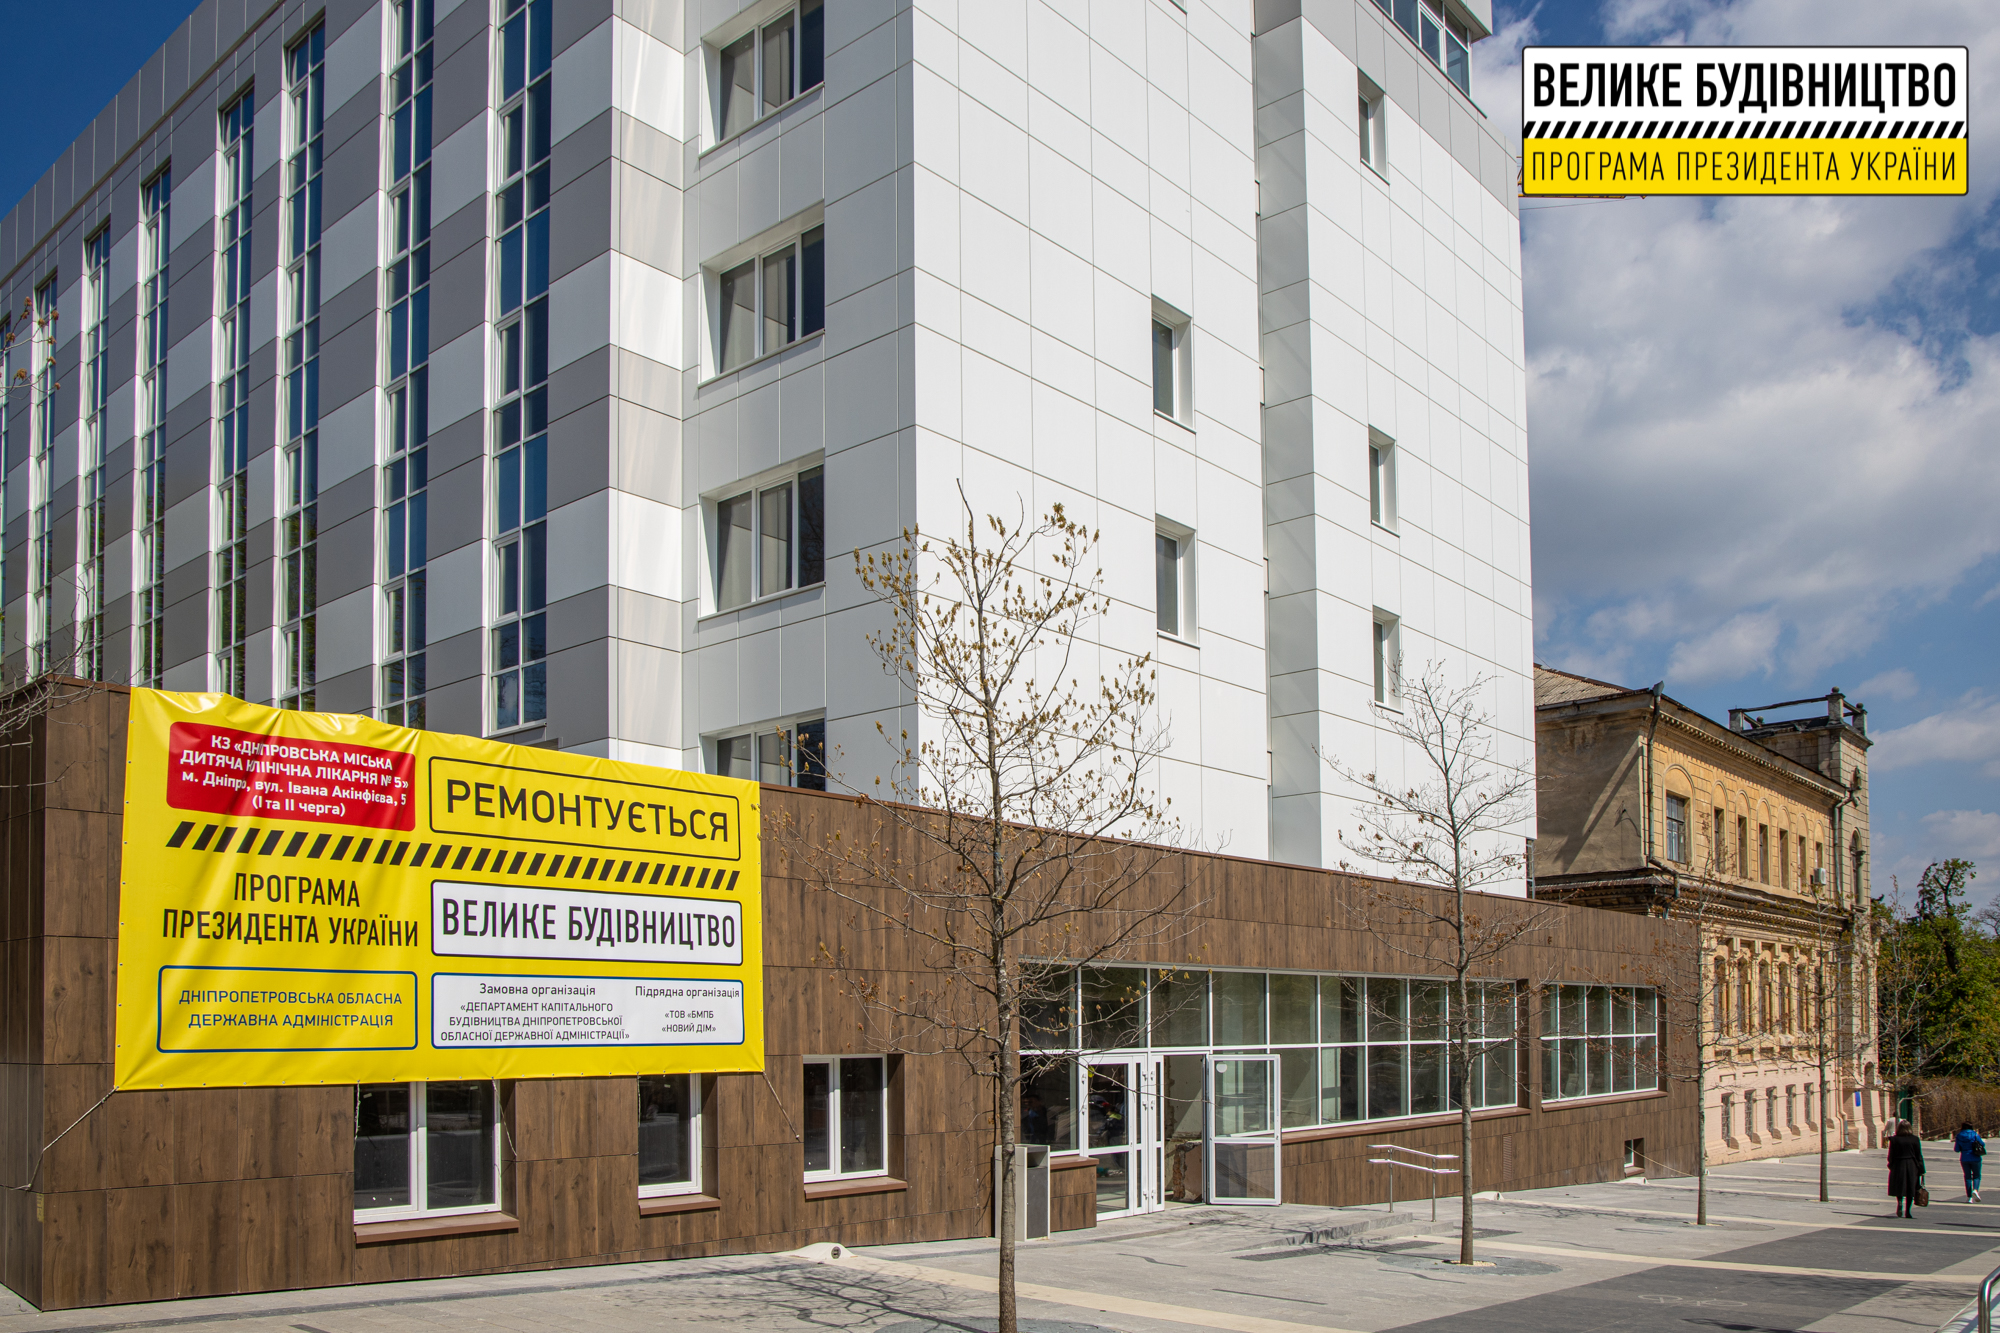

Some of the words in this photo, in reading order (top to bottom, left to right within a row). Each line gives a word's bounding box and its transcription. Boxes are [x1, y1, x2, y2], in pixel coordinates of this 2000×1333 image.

[211, 734, 231, 750] КЗ
[344, 752, 393, 771] МІСЬКА
[180, 749, 243, 771] ДИТЯЧА
[315, 766, 378, 787] ЛІКАРНЯ
[380, 774, 392, 787] №
[394, 776, 409, 789] 5»
[181, 771, 199, 783] м.
[202, 771, 251, 792] Дніпро,
[255, 780, 284, 794] вул.
[288, 781, 329, 797] Івана
[331, 785, 398, 807] Акінфієва,
[401, 793, 407, 806] 5
[265, 798, 280, 811] та
[299, 802, 346, 817] черга)
[447, 779, 728, 843] РЕМОНТУЄТЬСЯ
[234, 872, 361, 908] ПРОГРАМА
[162, 908, 320, 945] ПРЕЗИДЕНТА
[328, 914, 419, 947] УКРАЇНИ
[442, 898, 557, 940] ВЕЛИКЕ
[568, 905, 735, 950] БУДІВНИЦТВО
[179, 990, 334, 1005] ДНІПРОПЕТРОВСЬКА
[337, 992, 402, 1005] ОБЛАСНА
[479, 983, 529, 995] Замовна
[531, 985, 596, 997] організація
[635, 986, 684, 998] Підрядна
[686, 987, 740, 999] організація
[460, 1002, 539, 1013] «ДЕПАРТАМЕНТ
[541, 1002, 613, 1012] КАПІТАЛЬНОГО
[664, 1010, 686, 1019] «ТОВ
[687, 1010, 714, 1019] «БМПБ
[188, 1013, 278, 1029] ДЕРЖАВНА
[282, 1014, 393, 1029] АДМІНІСТРАЦІЯ
[449, 1016, 521, 1027] БУДІВНИЦТВА
[522, 1015, 623, 1027] ДНІПРОПЕТРОВСЬКОЇ
[661, 1023, 695, 1033] «НОВИЙ
[696, 1024, 717, 1034] ДІМ»
[440, 1030, 493, 1041] ОБЛАСНОЇ
[494, 1029, 553, 1042] ДЕРЖАВНОЇ
[555, 1028, 630, 1041] АДМІНІСТРАЦІЇ»
